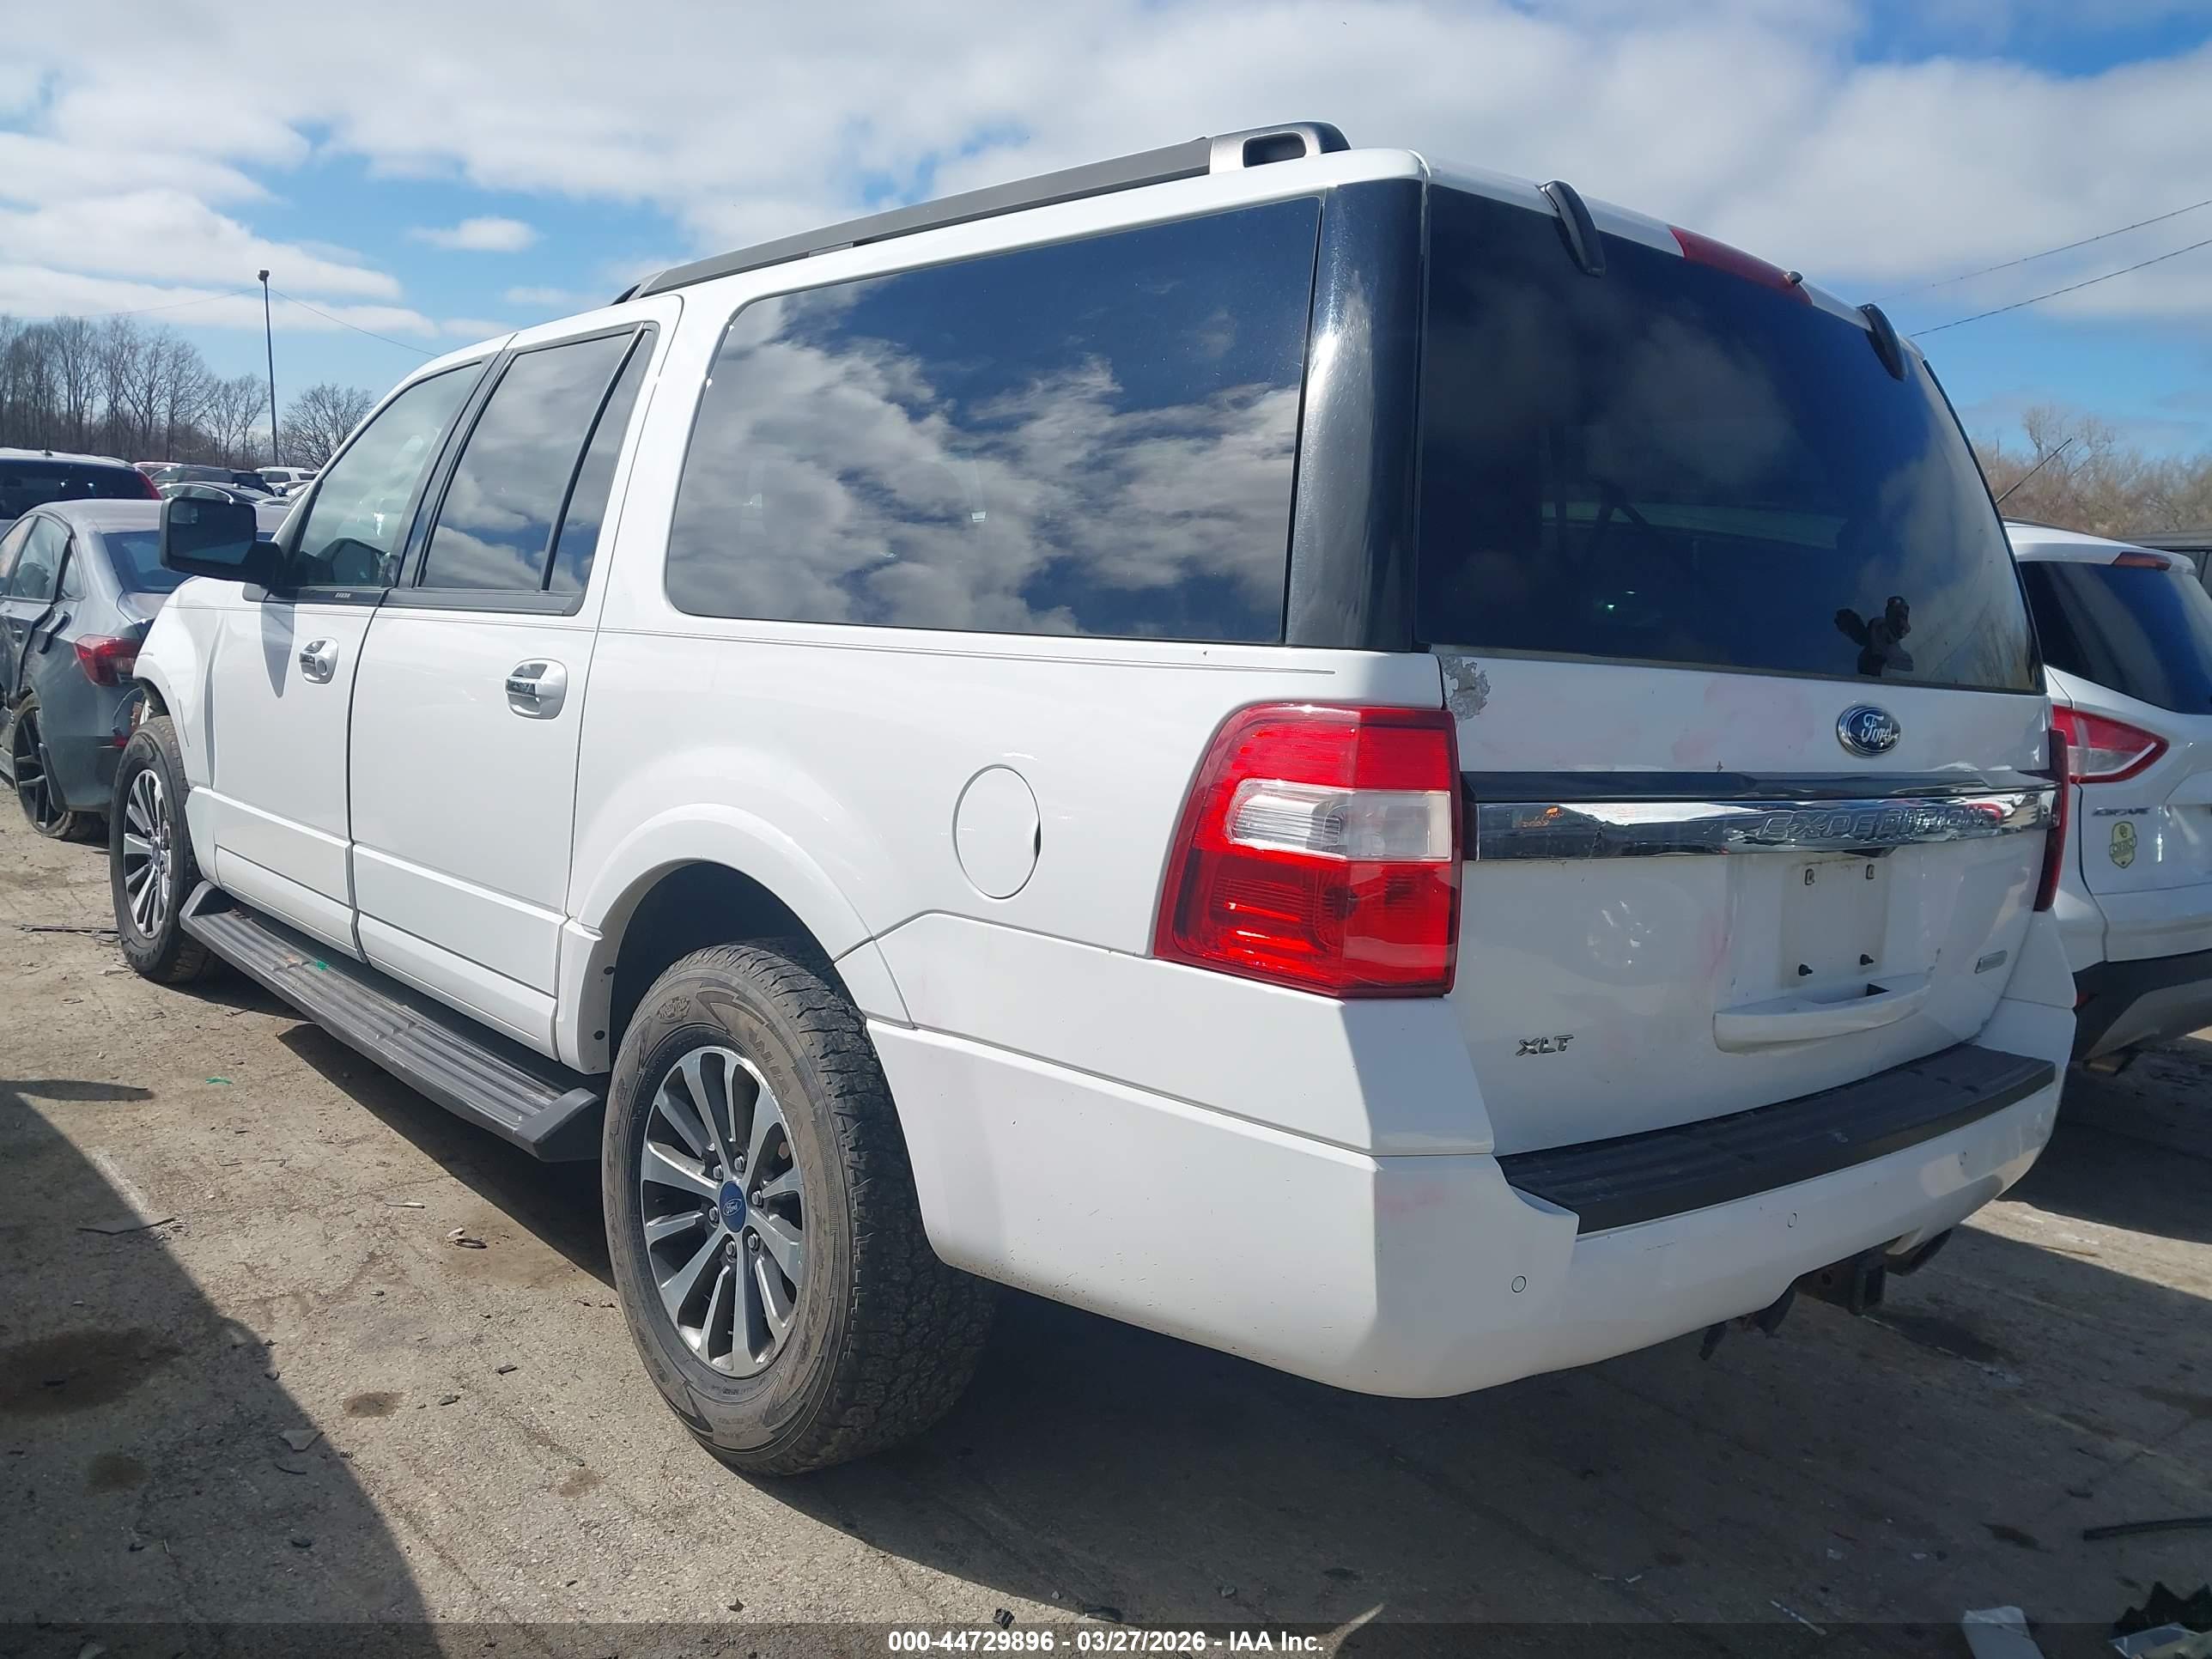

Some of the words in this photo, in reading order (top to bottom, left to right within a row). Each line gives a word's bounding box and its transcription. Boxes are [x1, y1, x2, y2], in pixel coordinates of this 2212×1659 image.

[1861, 714, 1899, 744] Ford
[1758, 806, 1986, 839] EXPEDITION
[1516, 1034, 1574, 1056] XLT
